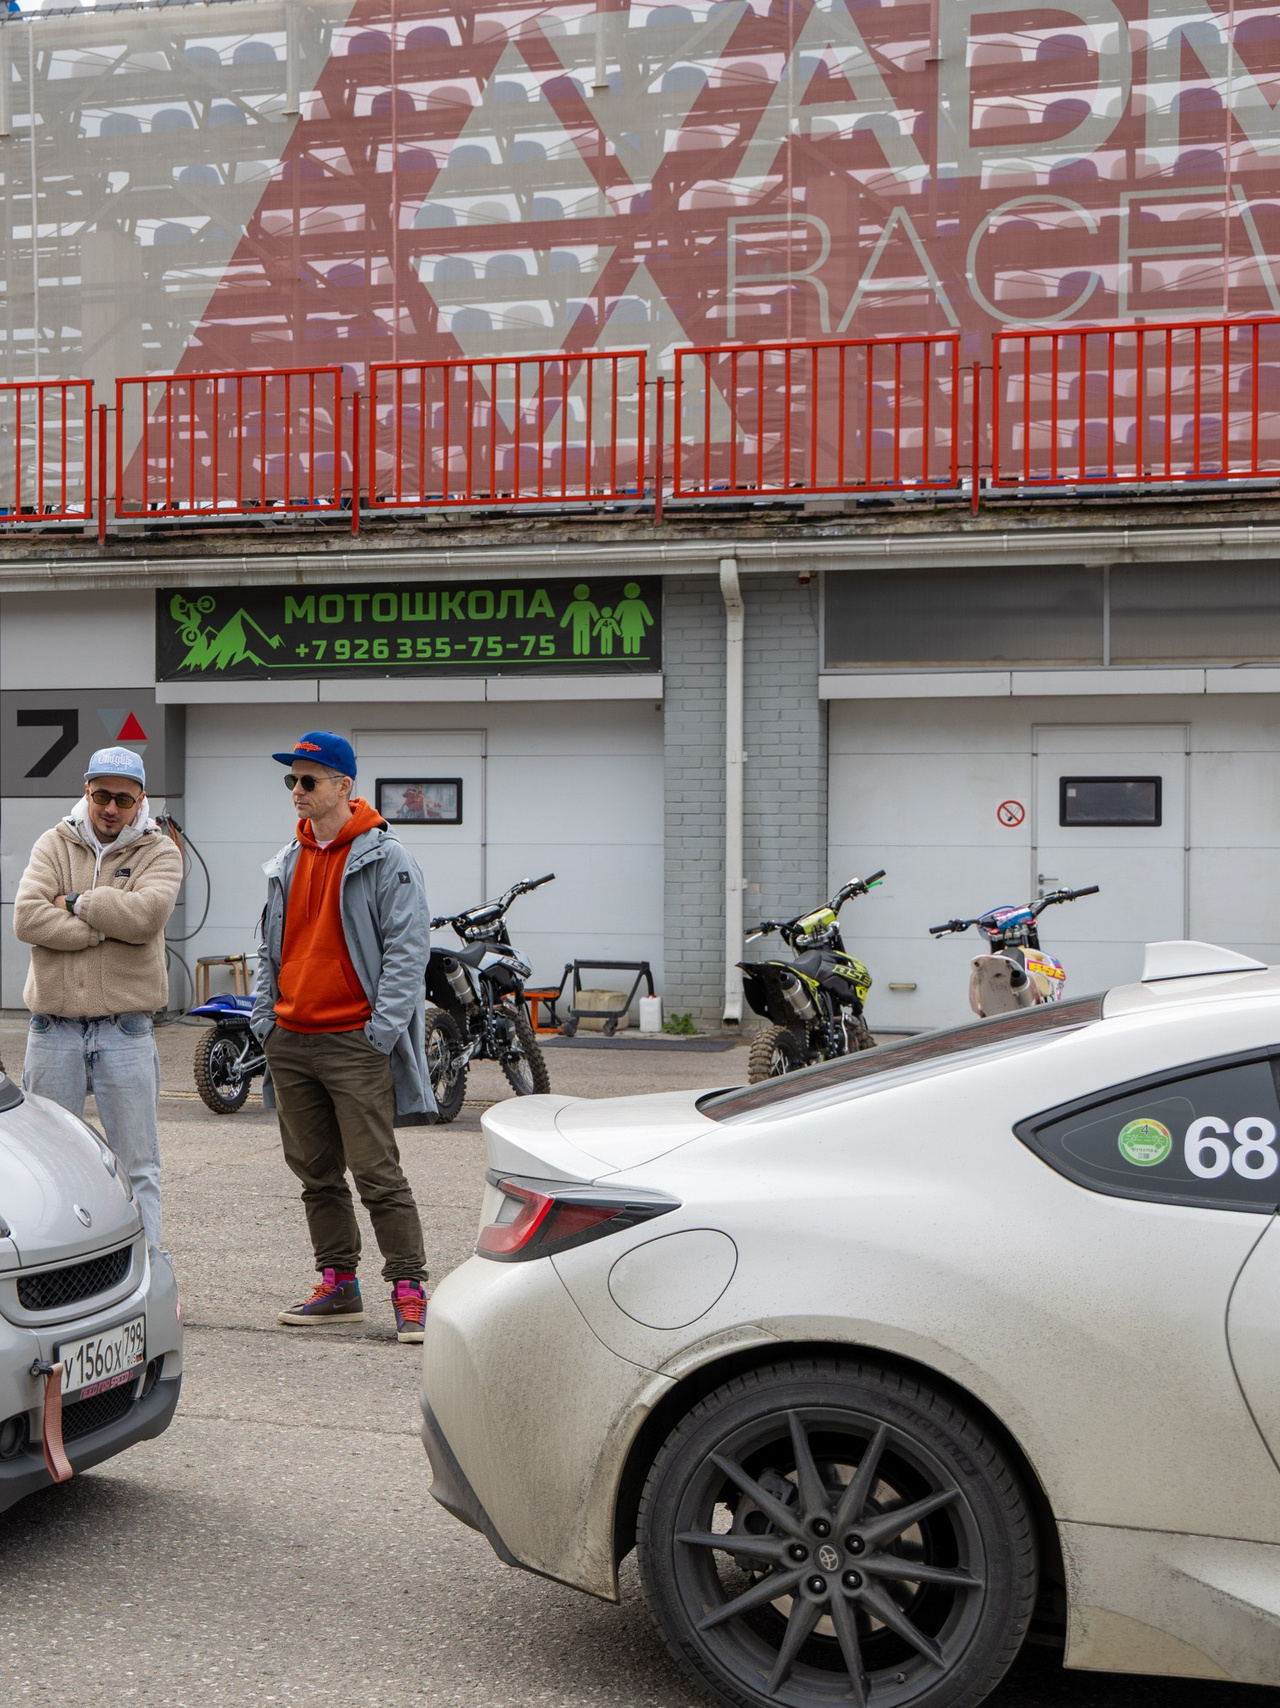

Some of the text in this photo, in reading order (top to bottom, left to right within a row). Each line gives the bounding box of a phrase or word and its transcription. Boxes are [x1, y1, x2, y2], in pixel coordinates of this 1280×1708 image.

[726, 183, 1280, 339] RACE
[283, 588, 556, 624] МОТОШКОЛА
[295, 635, 556, 660] +7 926 355-75-75
[17, 709, 79, 778] 7
[1184, 1116, 1278, 1180] 68
[124, 1322, 142, 1356] 799
